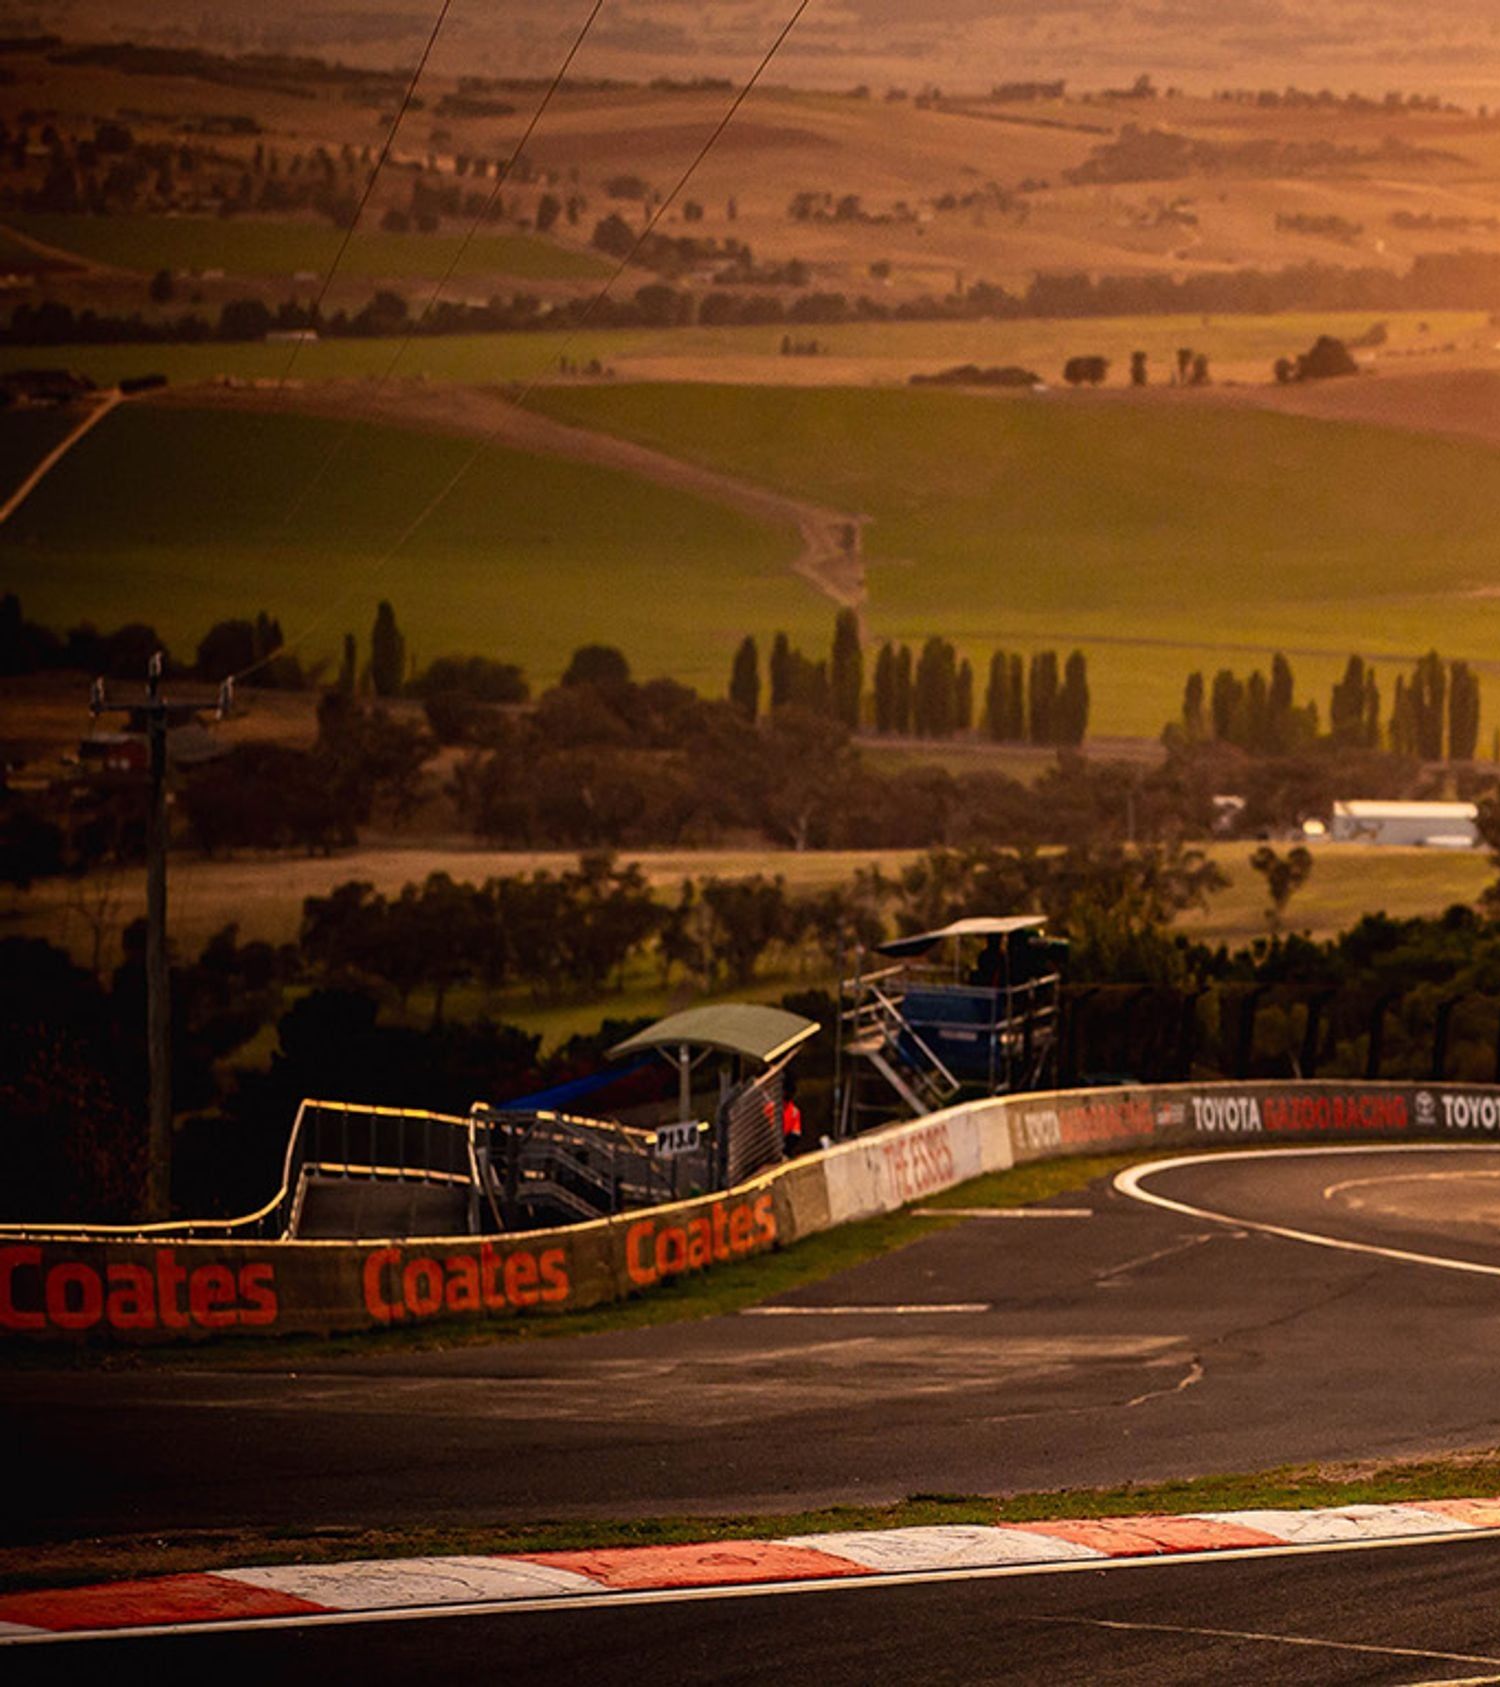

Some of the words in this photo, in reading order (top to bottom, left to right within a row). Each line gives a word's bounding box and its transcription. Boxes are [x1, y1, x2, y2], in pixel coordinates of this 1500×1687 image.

[1192, 1096, 1262, 1132] TOYOTA
[1263, 1096, 1330, 1131] GAZOO
[627, 1195, 776, 1284] Coates
[0, 1246, 277, 1329] Coates
[365, 1243, 569, 1321] Coates
